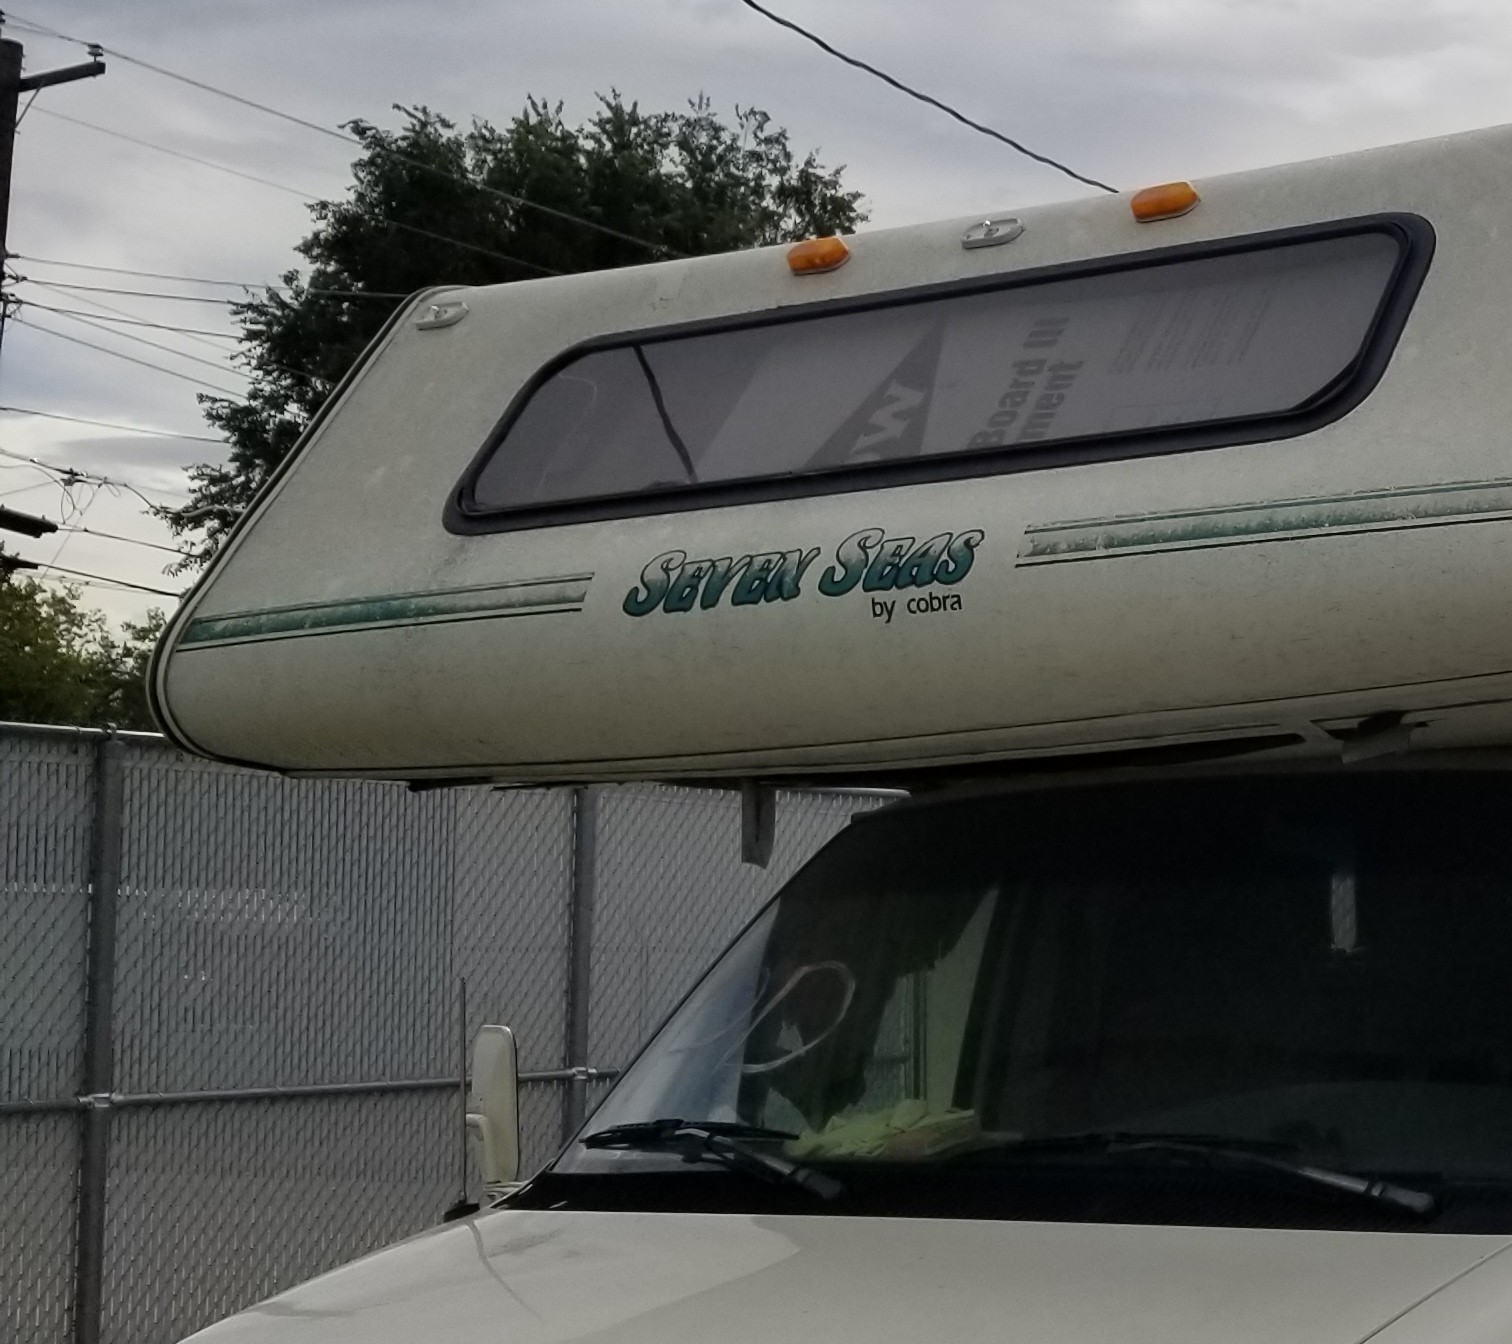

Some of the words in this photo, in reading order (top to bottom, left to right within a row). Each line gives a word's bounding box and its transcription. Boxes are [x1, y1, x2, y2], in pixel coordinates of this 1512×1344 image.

[621, 547, 821, 617] SEVEN
[817, 526, 986, 597] SEAS
[870, 596, 897, 623] by
[906, 592, 964, 615] cobra
